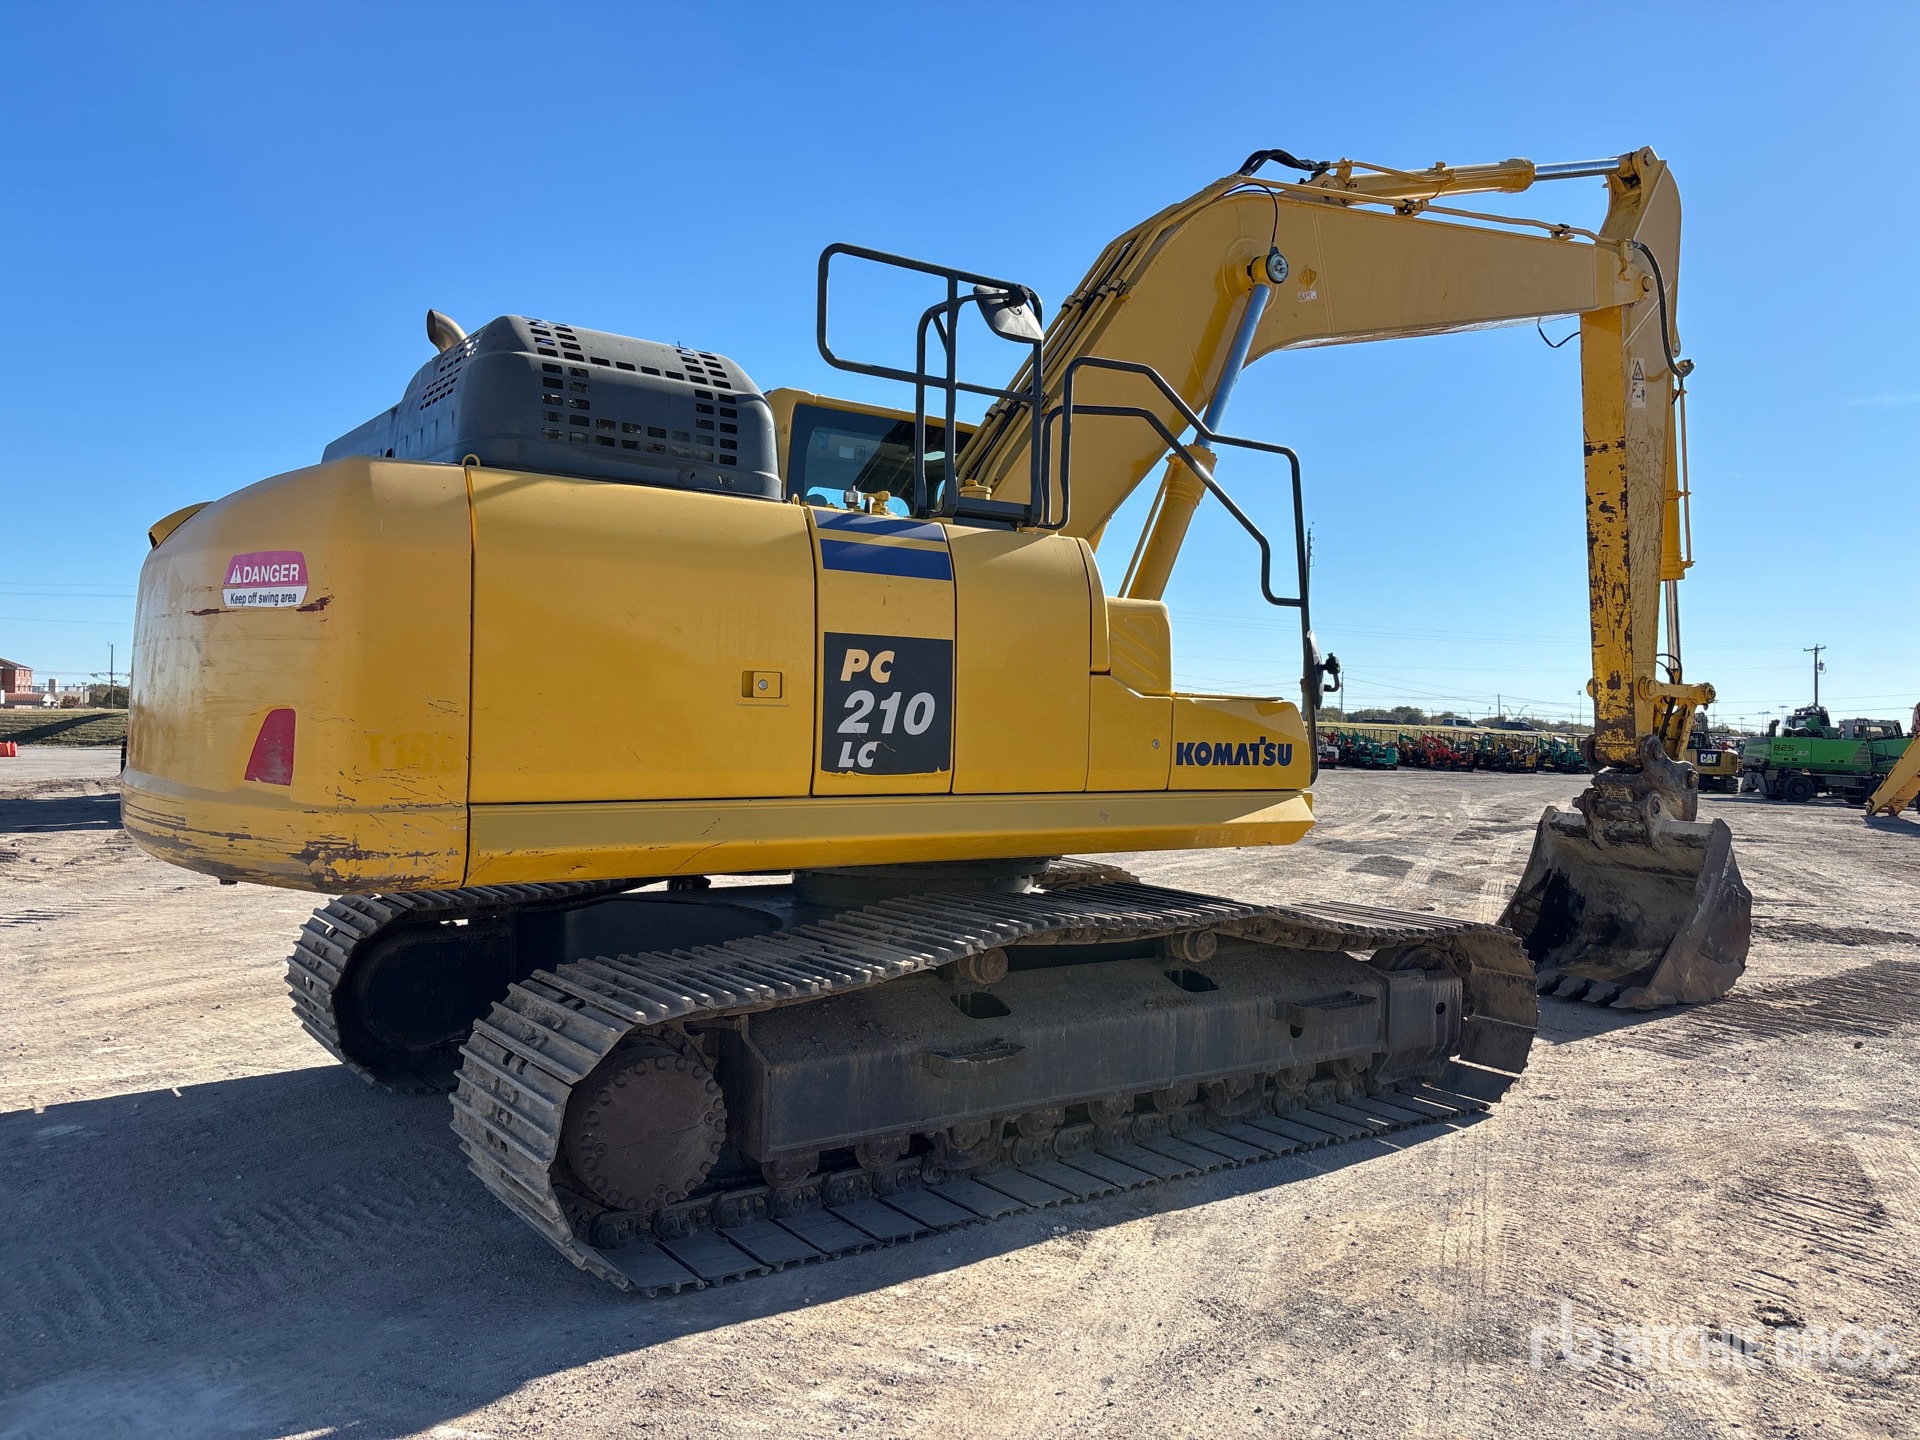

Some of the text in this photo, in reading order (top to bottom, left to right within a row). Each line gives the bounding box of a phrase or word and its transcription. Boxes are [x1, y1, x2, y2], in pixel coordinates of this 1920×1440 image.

[243, 564, 300, 583] DANGER
[230, 591, 297, 606] Keep off swing area
[840, 648, 895, 684] PC
[837, 689, 936, 736] 210
[838, 741, 878, 768] LC
[1176, 736, 1293, 767] KOMATSU
[1700, 753, 1718, 764] CAT
